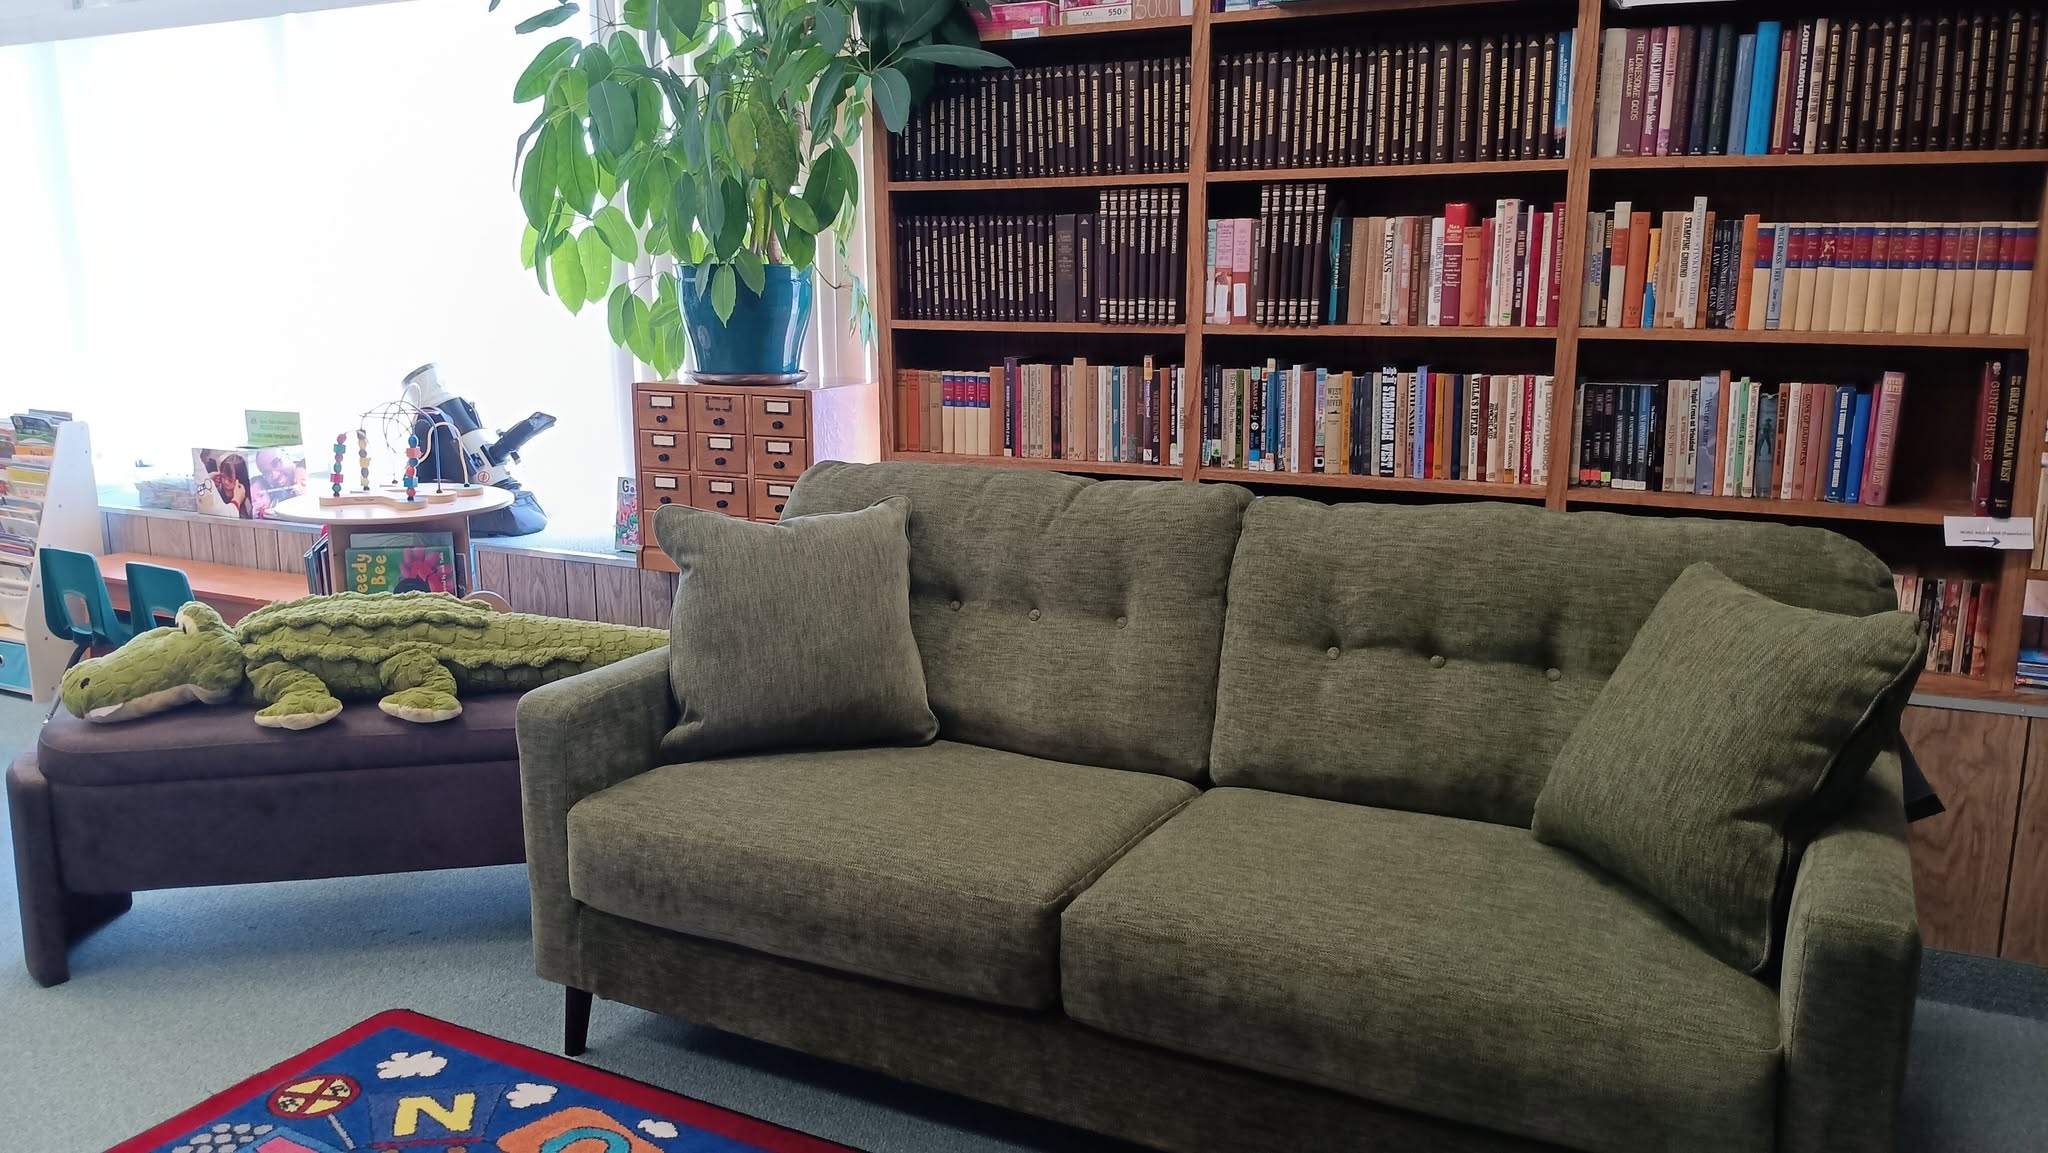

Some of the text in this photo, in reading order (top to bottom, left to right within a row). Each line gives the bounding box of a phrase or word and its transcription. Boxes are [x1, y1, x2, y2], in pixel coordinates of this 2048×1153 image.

[1108, 8, 1122, 16] 550
[1637, 35, 1645, 52] THE
[1800, 25, 1810, 54] LOUIS
[1633, 54, 1644, 98] LONESOME
[1645, 43, 1663, 135] LOUIS L'AMOUR Trouble Shooter
[1796, 56, 1807, 98] L'AMOUR
[1384, 233, 1394, 273] TEXANS
[1680, 217, 1692, 277] STAMPING GROUND
[1691, 243, 1700, 279] STINKING
[1713, 246, 1721, 266] LAW
[1775, 226, 1785, 263] WILDERNESS
[1718, 288, 1726, 310] MOON
[1470, 378, 1480, 435] VILLA'S RIFLES
[1704, 399, 1713, 428] Western
[1841, 393, 1849, 408] LOUIS
[1381, 386, 1395, 467] STAGECOACH WEST
[1804, 416, 1810, 425] OF
[1879, 403, 1895, 436] DICTIONARY
[1983, 381, 2000, 460] GUNFIGHTERS
[2000, 387, 2021, 482] GREAT AMERICAN WEST
[1800, 427, 1808, 466] DARKNESS
[1836, 437, 1844, 450] LAST
[1876, 446, 1888, 457] THE
[1872, 471, 1883, 486] WEST
[1875, 458, 1885, 469] OLD
[352, 554, 372, 592] eedy
[371, 555, 386, 585] Bee
[394, 1093, 475, 1136] N
